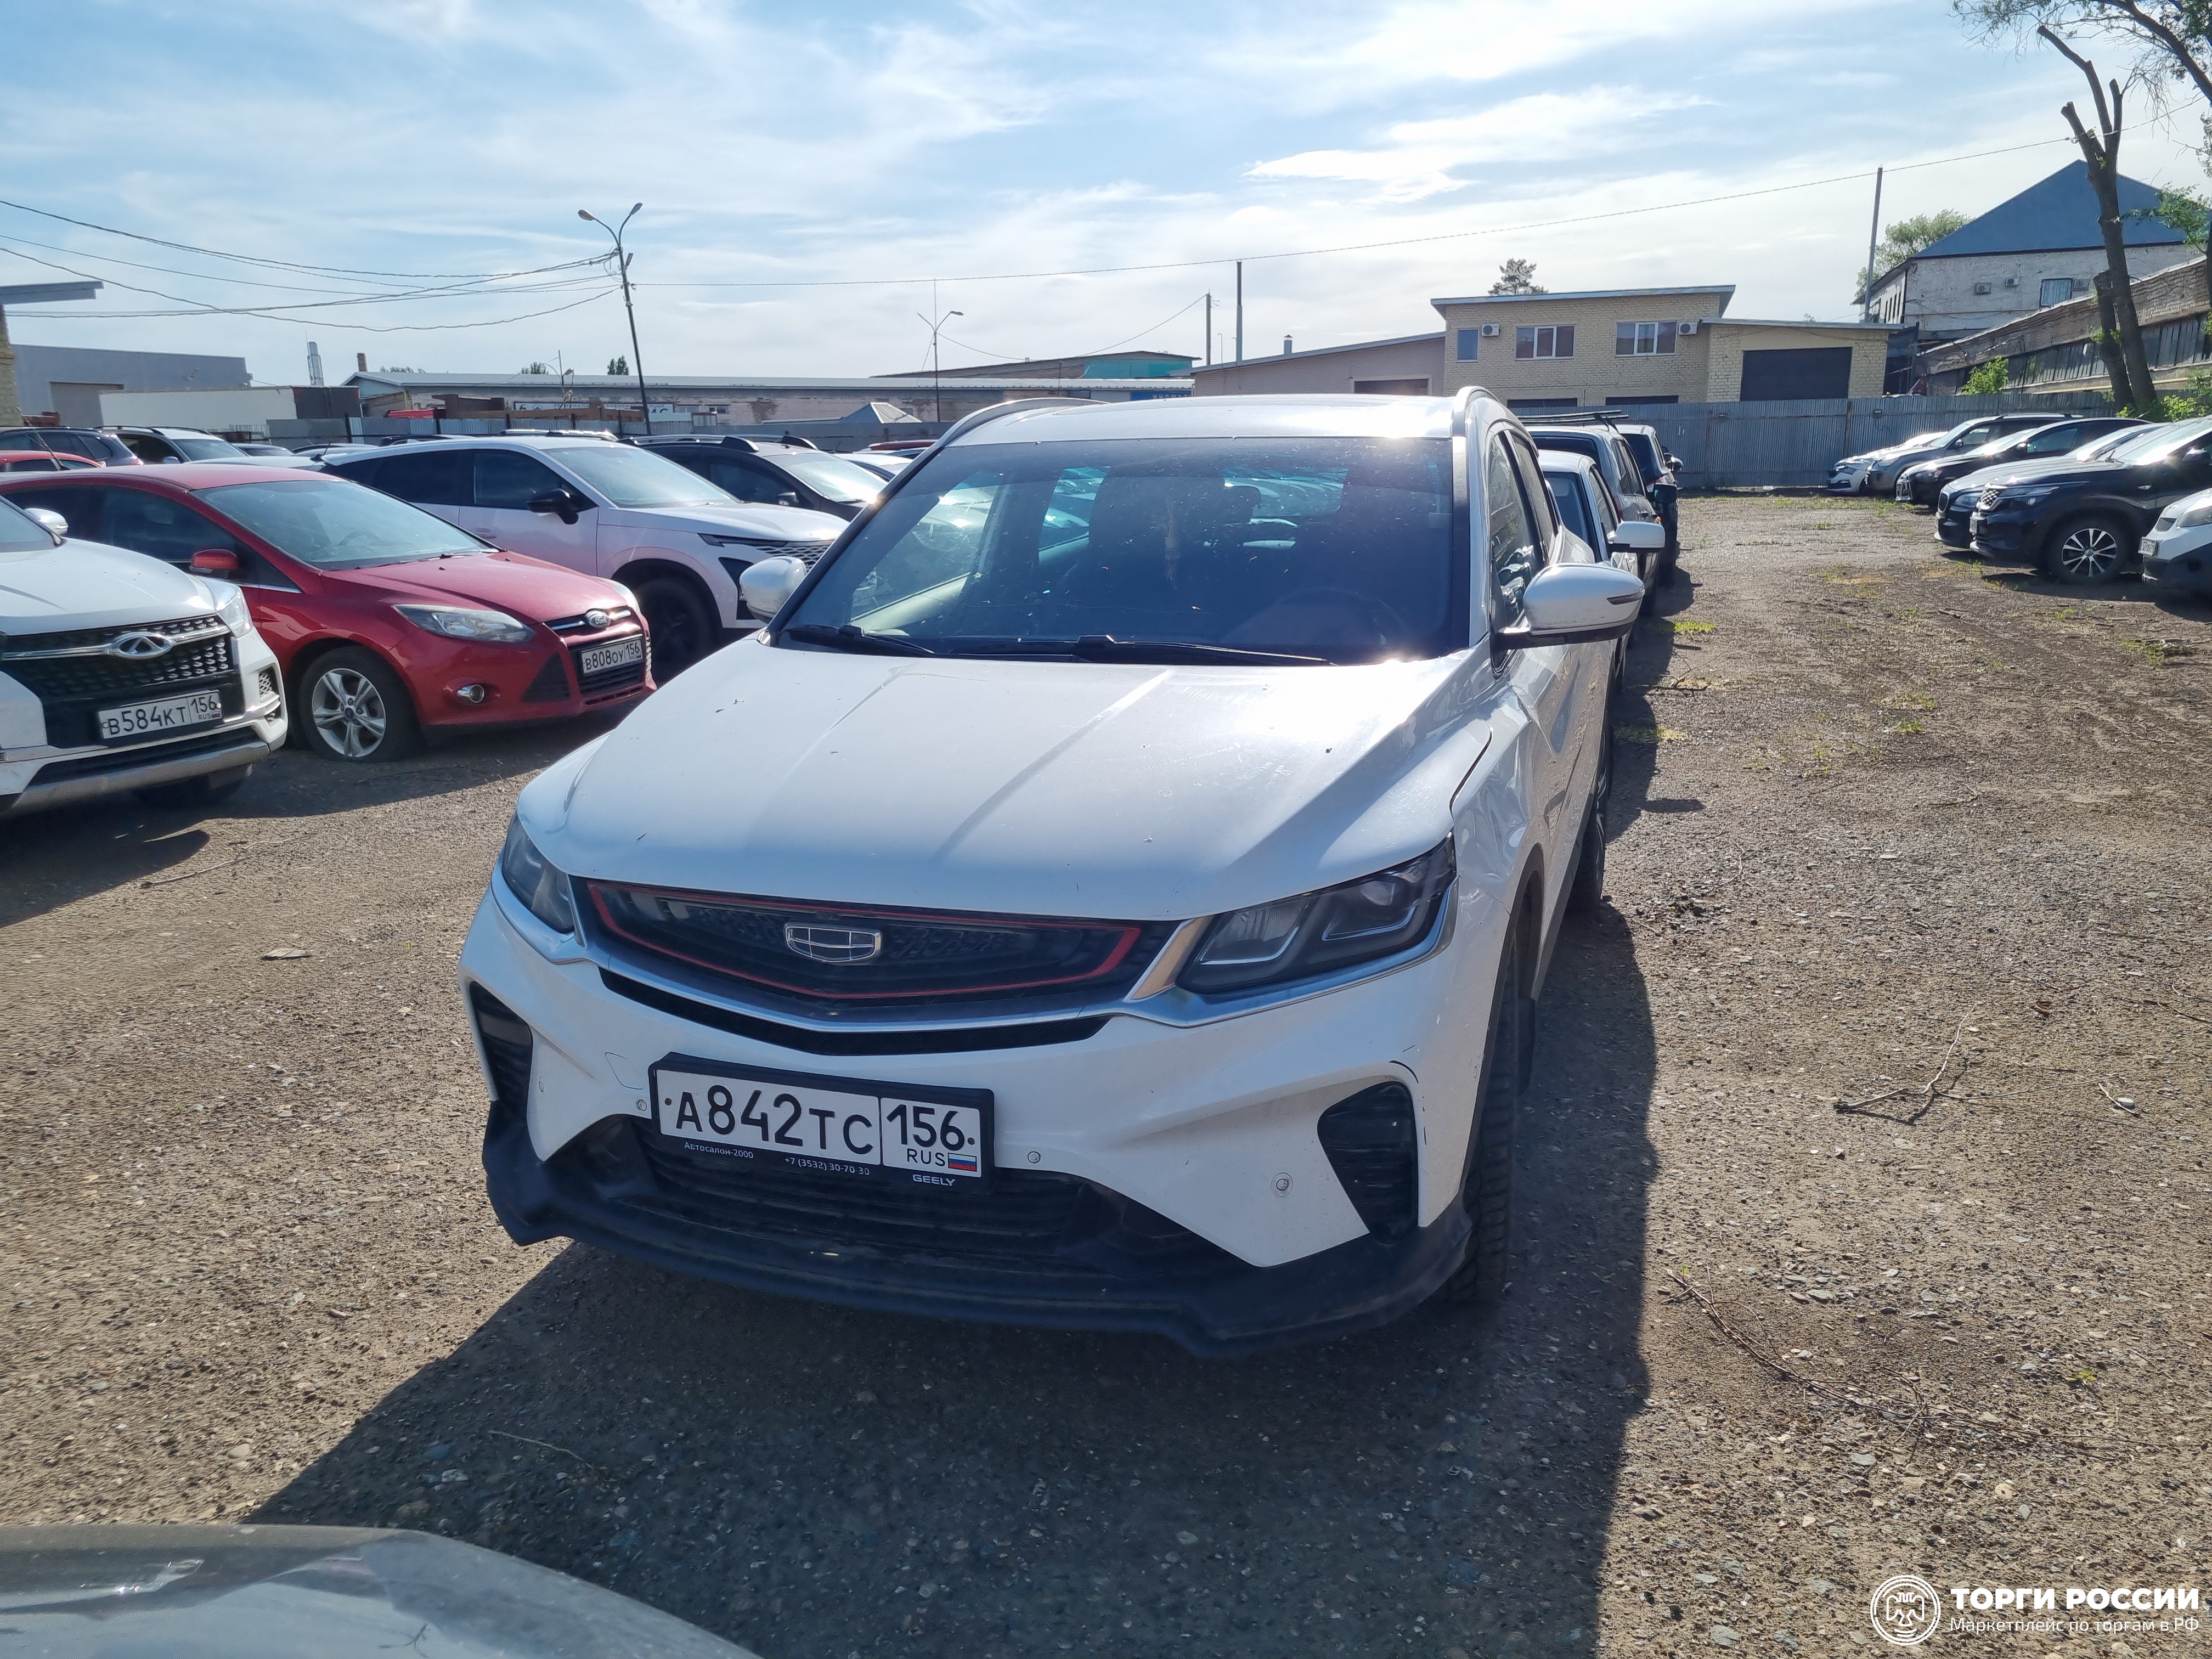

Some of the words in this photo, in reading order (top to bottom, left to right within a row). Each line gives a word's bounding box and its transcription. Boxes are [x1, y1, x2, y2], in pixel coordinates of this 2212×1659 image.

[585, 650, 623, 670] В808ОУ
[625, 642, 640, 656] 156
[108, 706, 185, 735] В584КТ
[190, 696, 216, 714] 156
[676, 1085, 873, 1154] А842ТС
[886, 1104, 965, 1151] 156
[684, 1142, 754, 1159] Автосалон-2000
[798, 1158, 827, 1171] (3532)
[907, 1148, 945, 1167] RUS
[912, 1174, 955, 1186] GEELY
